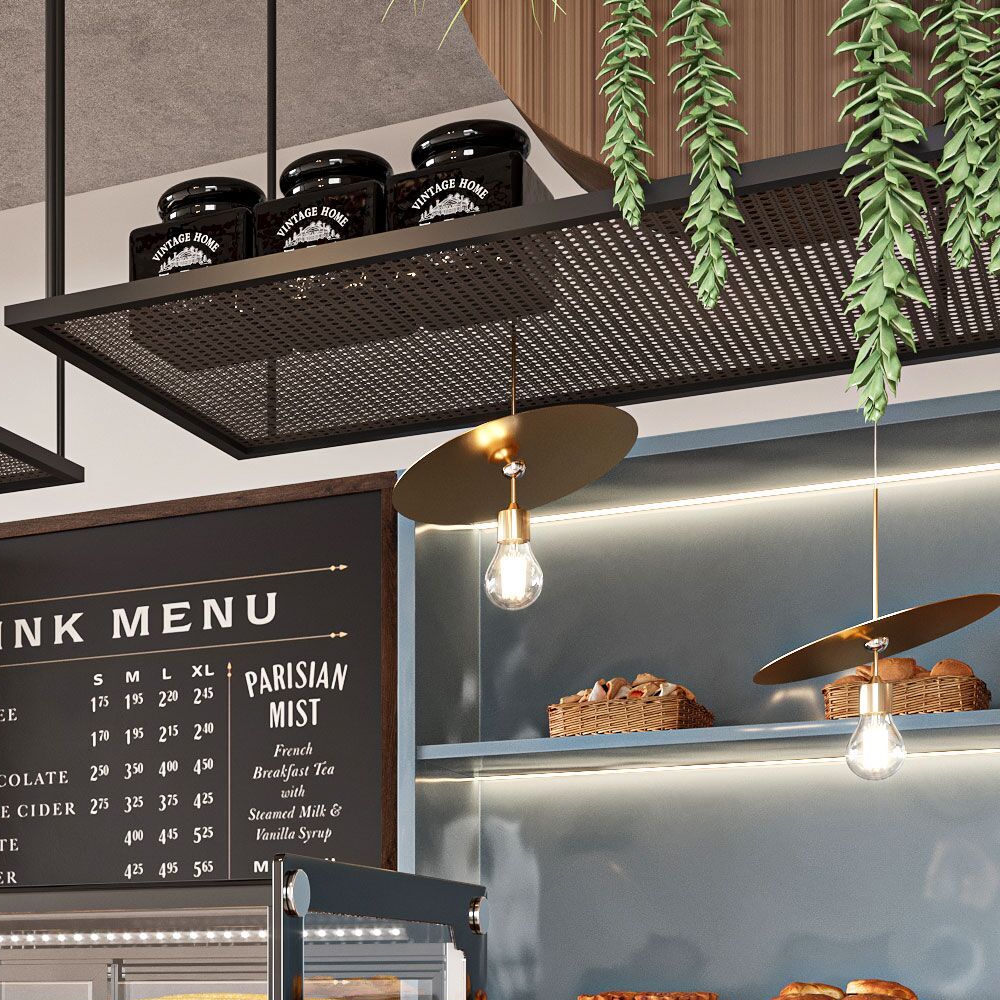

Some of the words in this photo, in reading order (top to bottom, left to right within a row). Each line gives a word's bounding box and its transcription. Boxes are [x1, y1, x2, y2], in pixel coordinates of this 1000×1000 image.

[411, 178, 456, 210] VINTAGE
[458, 178, 489, 200] HOME
[276, 206, 318, 237] VINTAGE
[320, 206, 349, 227] HOME
[151, 232, 191, 262] VINTAGE
[192, 231, 220, 252] HOME
[111, 592, 278, 639] MENU
[93, 673, 104, 686] S
[125, 670, 140, 683] M
[162, 667, 172, 680] L
[191, 664, 215, 678] XL
[244, 660, 348, 698] PARISIAN
[269, 697, 321, 729] MIST
[273, 741, 313, 759] French
[252, 763, 310, 782] Breakfast
[313, 760, 335, 776] Tea
[280, 784, 305, 798] with
[17, 802, 76, 818] CIDER
[247, 805, 296, 821] Steamed
[298, 804, 327, 818] Milk
[329, 803, 343, 817] &
[255, 827, 296, 841] Vanilla
[298, 826, 333, 844] Syrup
